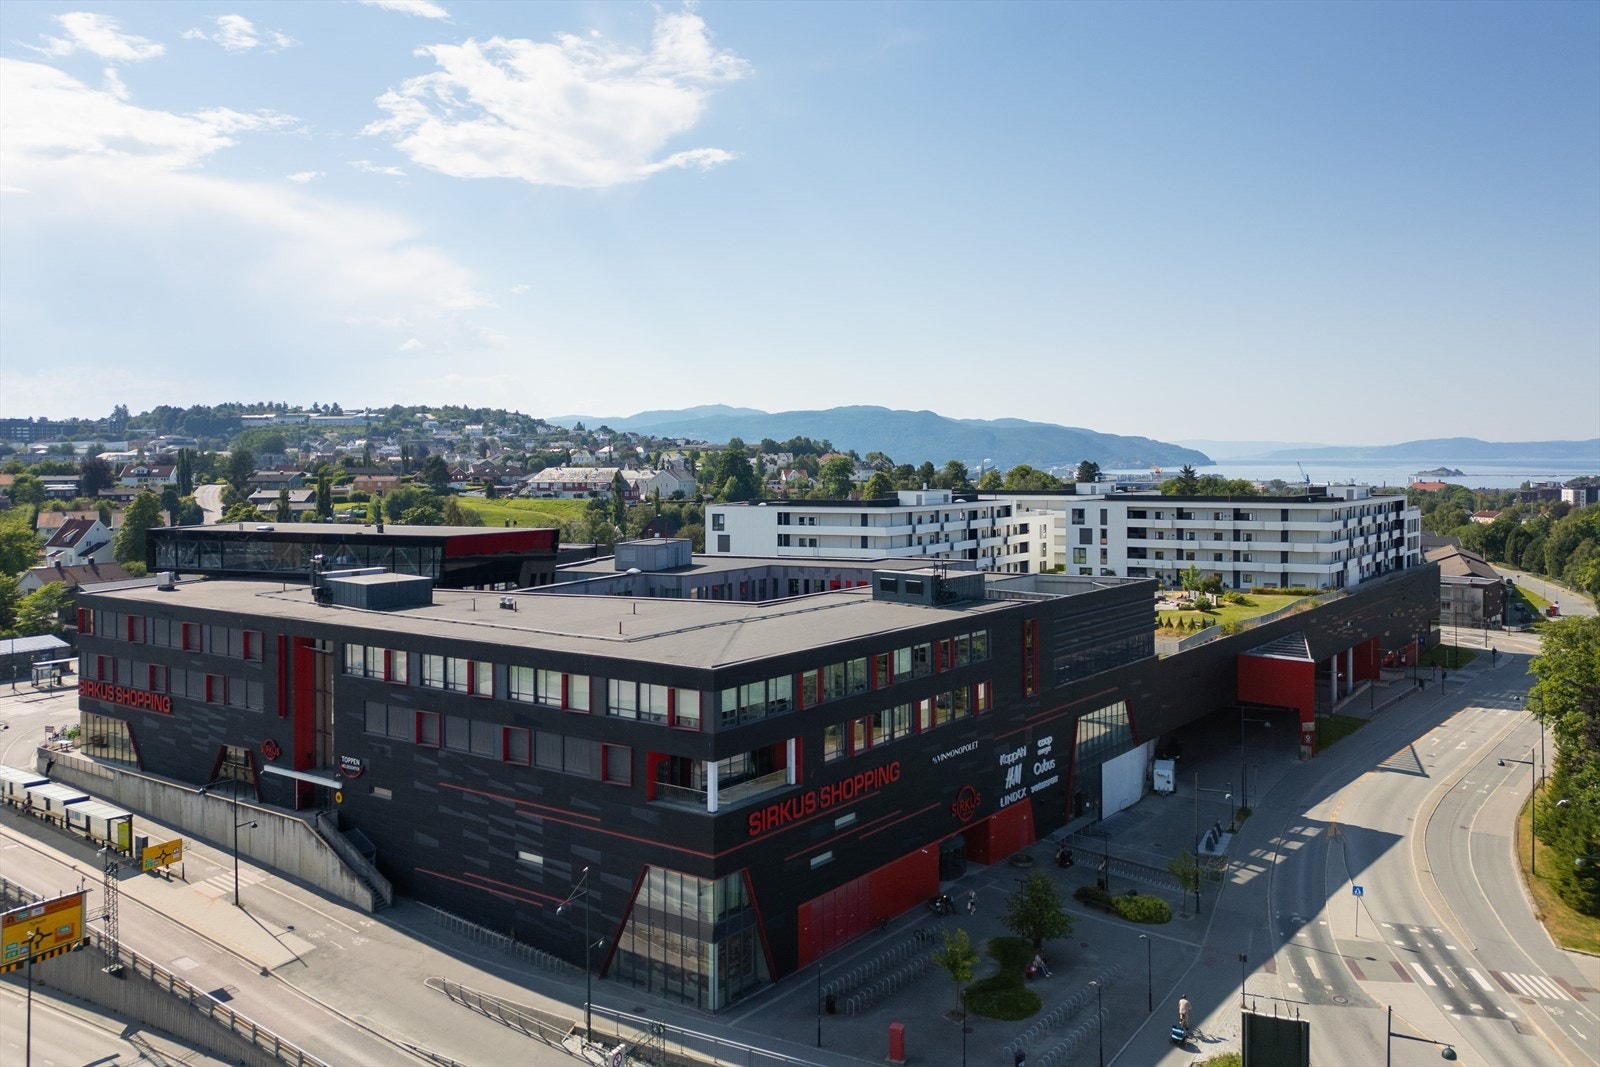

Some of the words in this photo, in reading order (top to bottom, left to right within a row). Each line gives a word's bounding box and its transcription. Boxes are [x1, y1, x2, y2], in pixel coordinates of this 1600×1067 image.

[78, 680, 114, 700] SIRKUS
[116, 687, 171, 713] SHOPPING
[341, 755, 361, 766] TOPPEN
[748, 791, 817, 836] SIRKUS
[820, 761, 900, 808] SHOPPING
[1000, 787, 1027, 807] LINDEX
